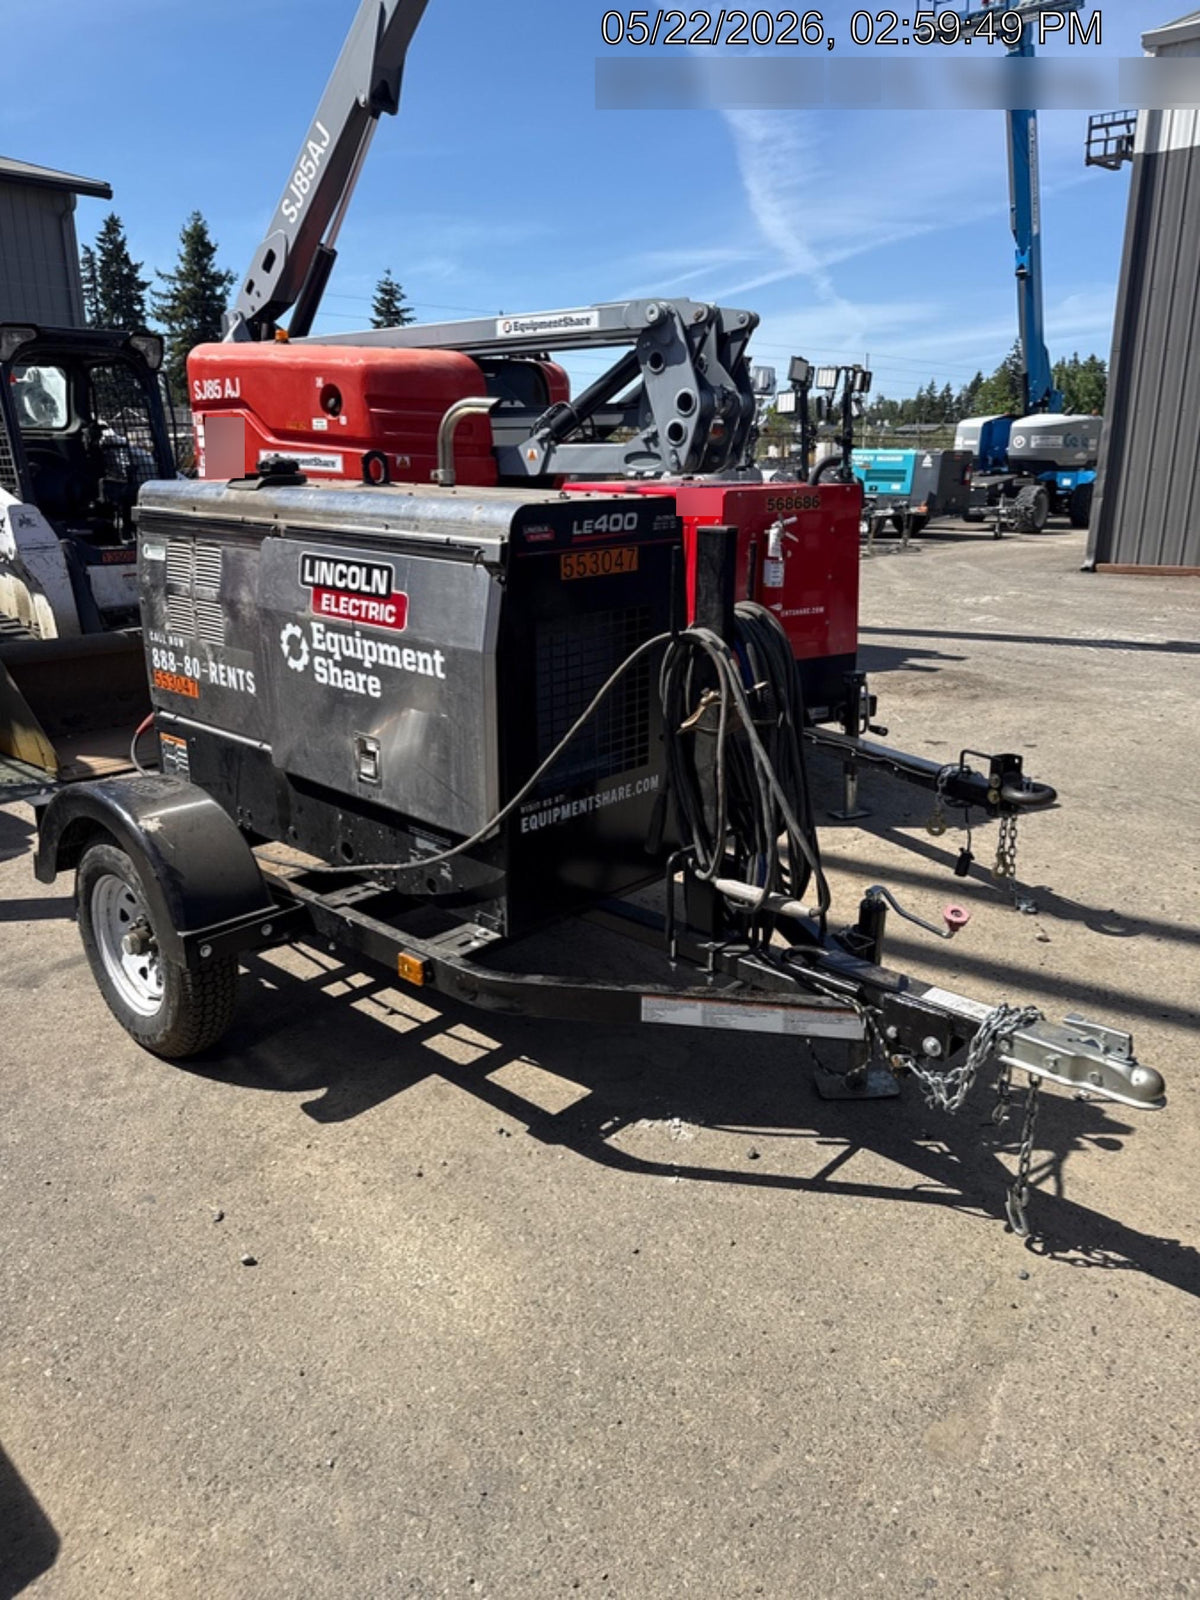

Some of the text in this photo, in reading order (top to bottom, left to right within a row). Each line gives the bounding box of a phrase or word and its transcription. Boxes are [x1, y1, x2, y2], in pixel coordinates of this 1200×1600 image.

[281, 120, 330, 223] SJ85AJ
[513, 316, 591, 332] EquipmentShare
[193, 377, 240, 399] SJ85 AJ
[767, 495, 820, 512] 568686
[572, 512, 638, 535] LE400
[303, 558, 389, 596] LINCOLN
[562, 548, 636, 578] 553047
[320, 593, 397, 624] ELECTRIC
[310, 621, 446, 680] Equipment
[151, 647, 257, 695] 888-80-RENTS
[313, 655, 382, 699] Share
[520, 774, 660, 834] EQUIPMENTSHARE.COM
